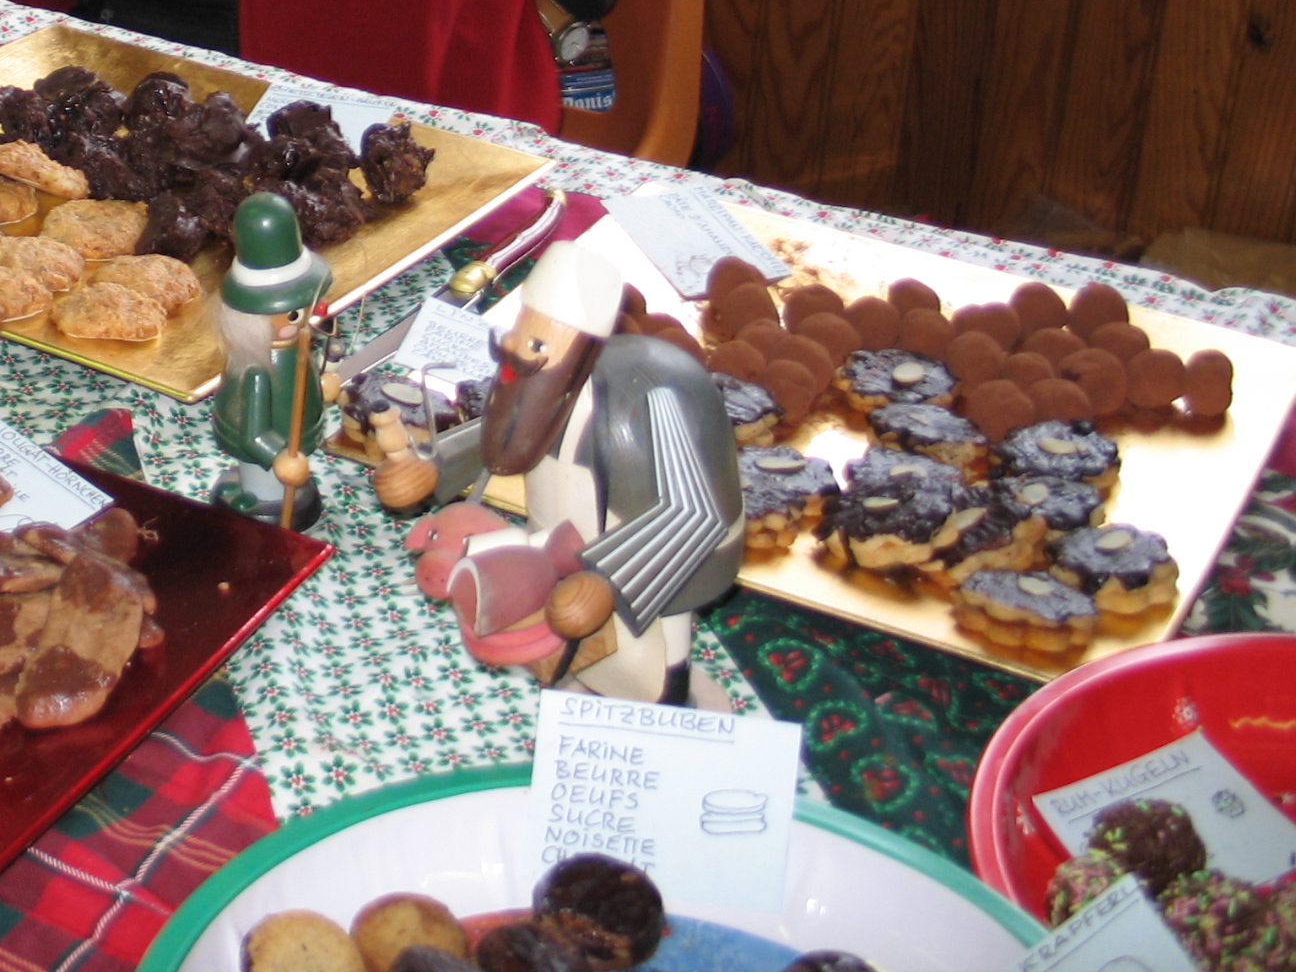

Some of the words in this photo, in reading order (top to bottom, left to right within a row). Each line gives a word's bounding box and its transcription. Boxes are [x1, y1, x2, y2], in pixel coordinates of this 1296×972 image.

[560, 696, 735, 734] SPITZBUBEN
[558, 734, 644, 766] FARINE
[554, 759, 660, 791] BEURRE
[551, 782, 639, 810] OEUFS
[548, 803, 636, 834] SUCRE
[544, 826, 655, 857] NOISETTE
